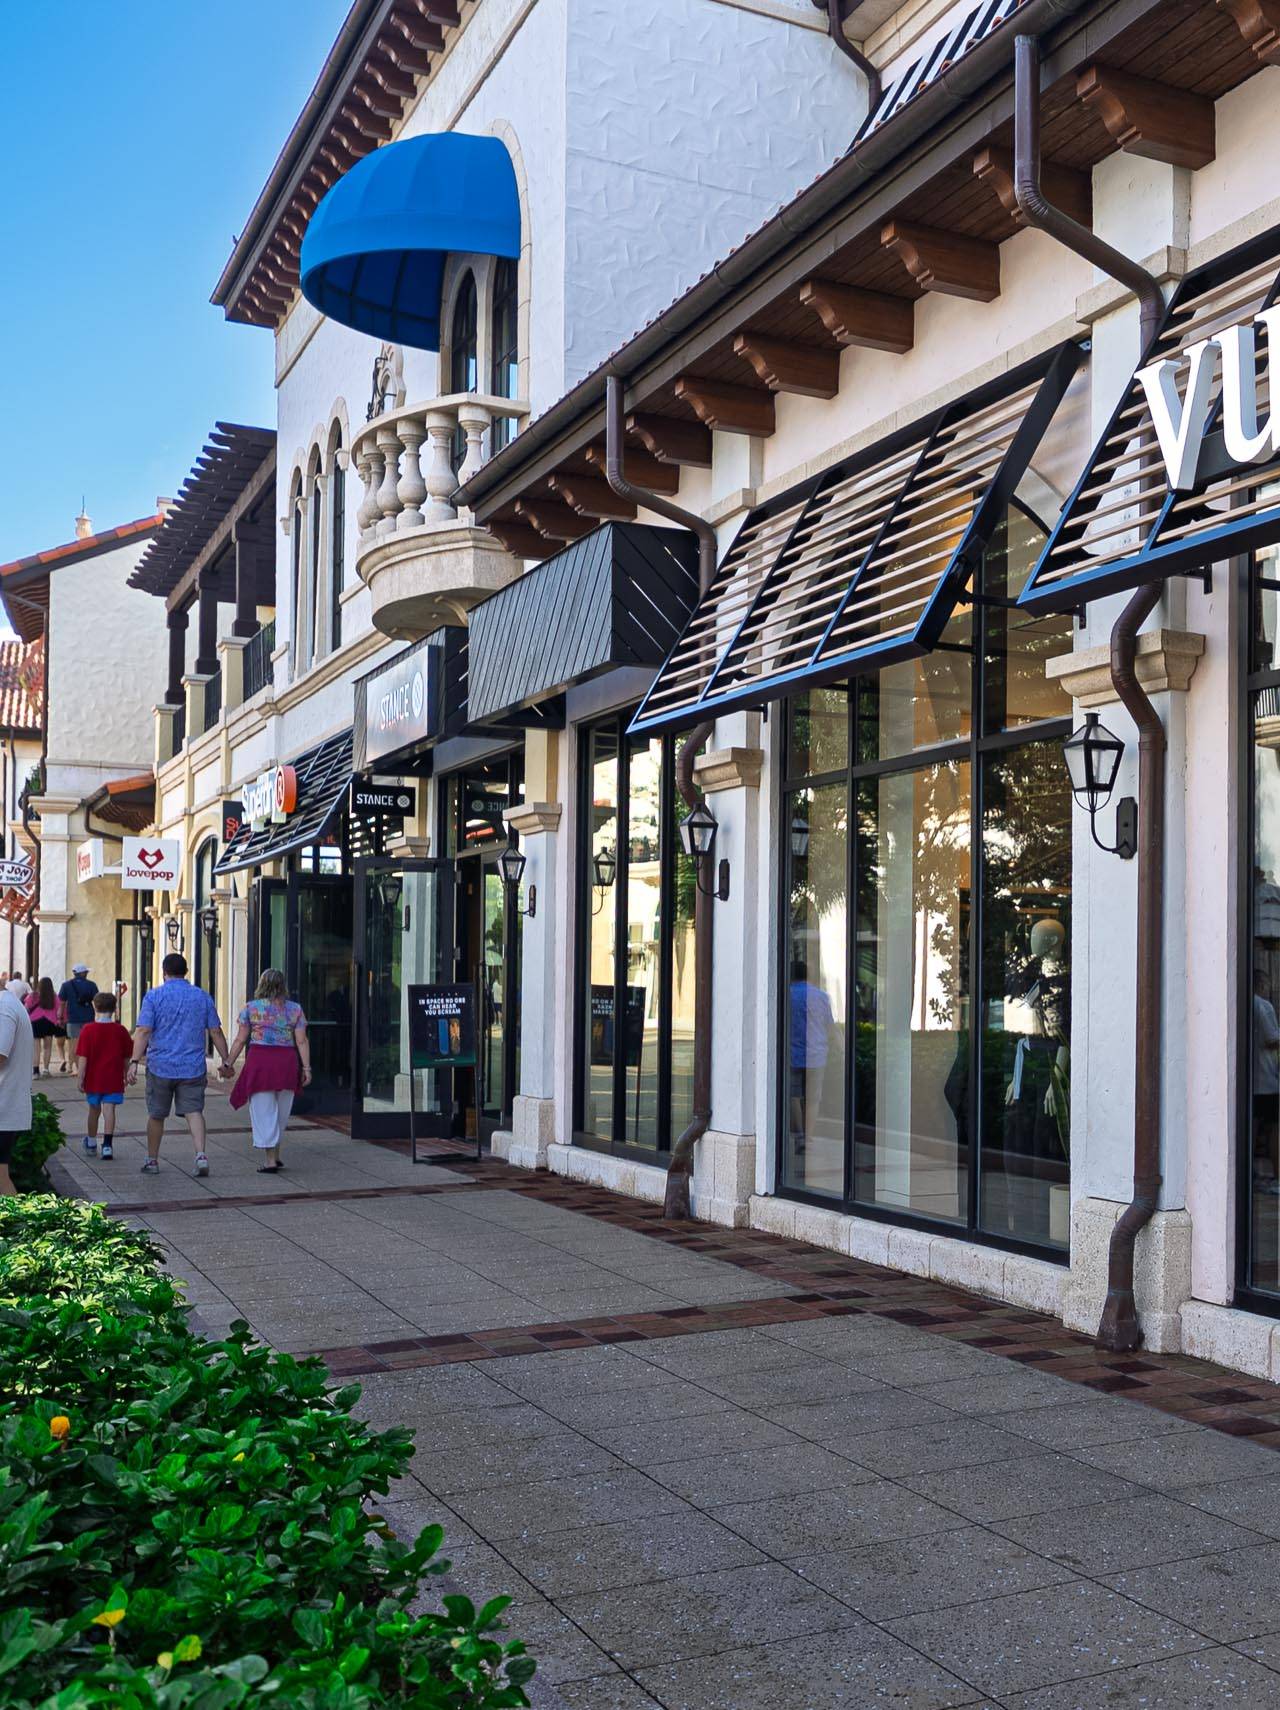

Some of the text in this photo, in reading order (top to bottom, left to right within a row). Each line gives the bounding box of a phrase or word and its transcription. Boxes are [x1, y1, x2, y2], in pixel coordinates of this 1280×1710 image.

[380, 682, 410, 731] STANCE
[356, 793, 394, 807] STANCE
[7, 866, 29, 877] JON
[126, 866, 174, 881] lovepop
